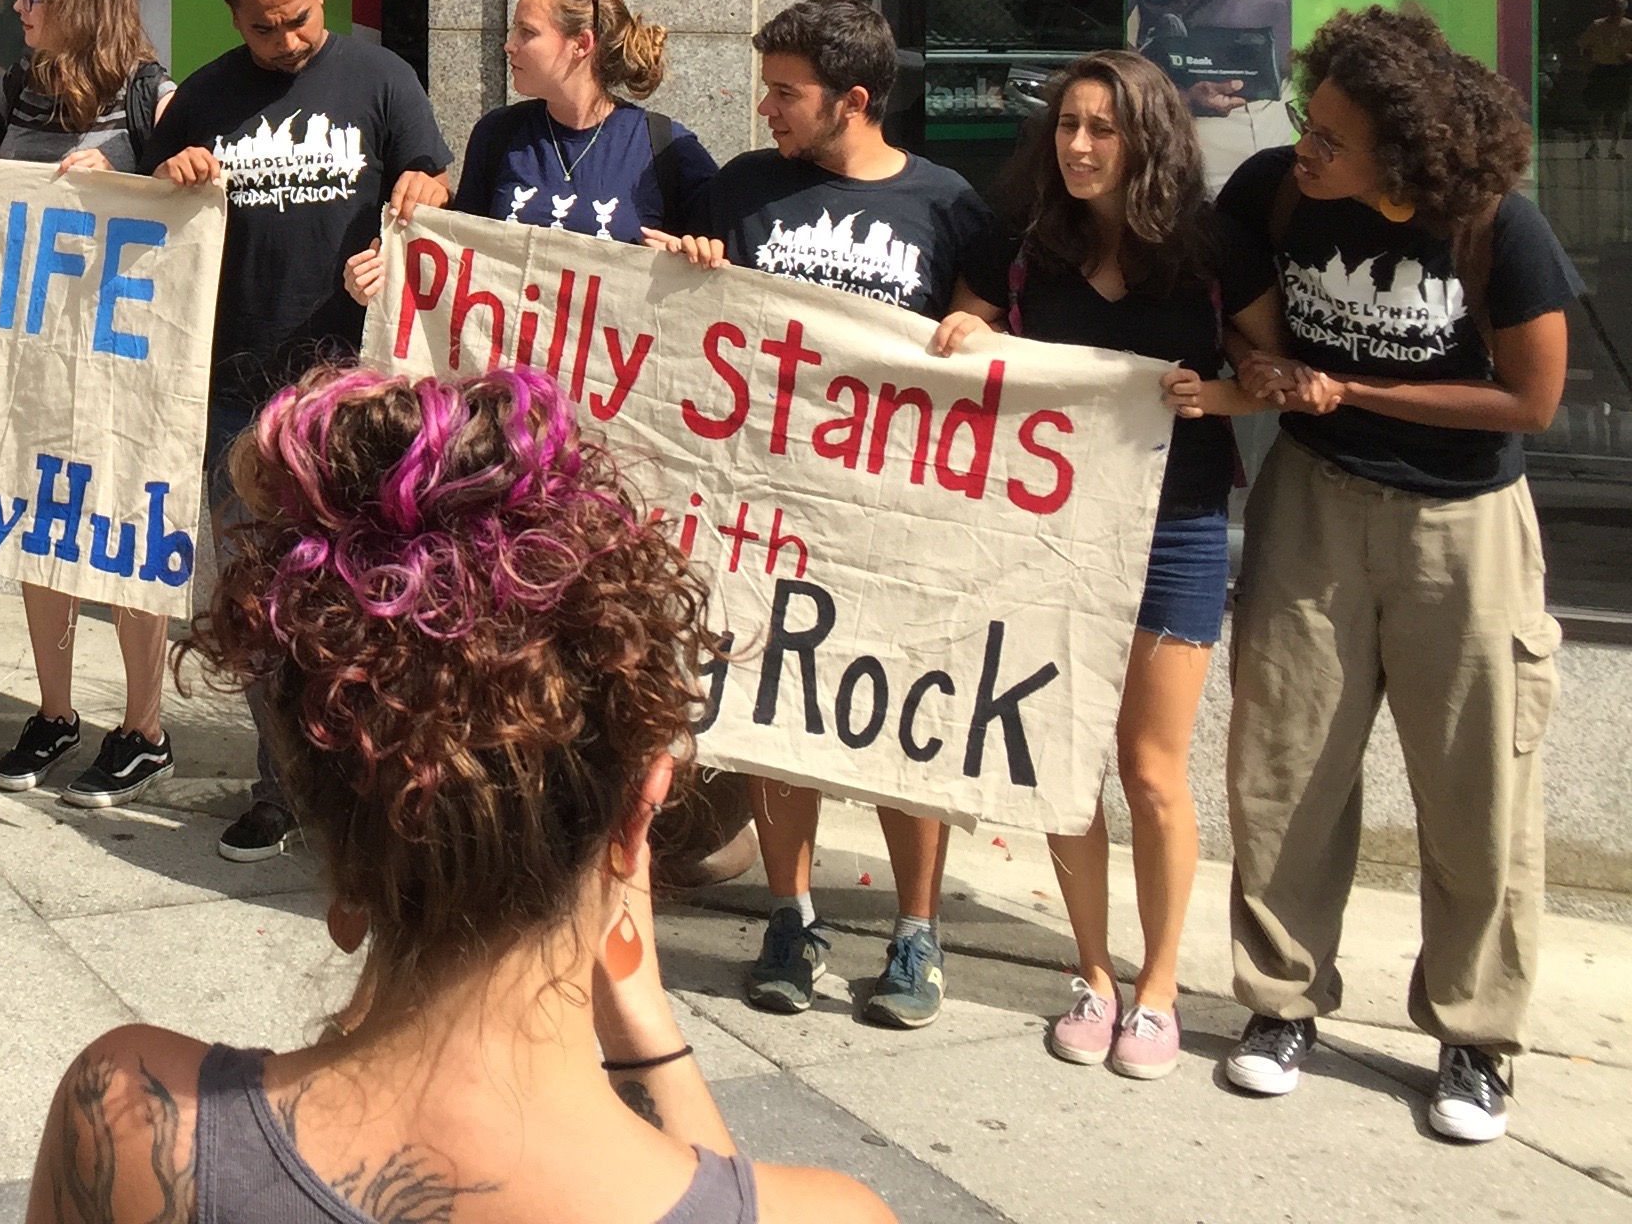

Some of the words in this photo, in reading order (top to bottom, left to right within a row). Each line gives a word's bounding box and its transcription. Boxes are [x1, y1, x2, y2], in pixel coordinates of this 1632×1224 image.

[1169, 54, 1183, 66] TD
[393, 237, 654, 422] Philly
[681, 319, 1074, 516] Stands
[651, 492, 808, 579] ith
[753, 578, 1060, 788] Rock
